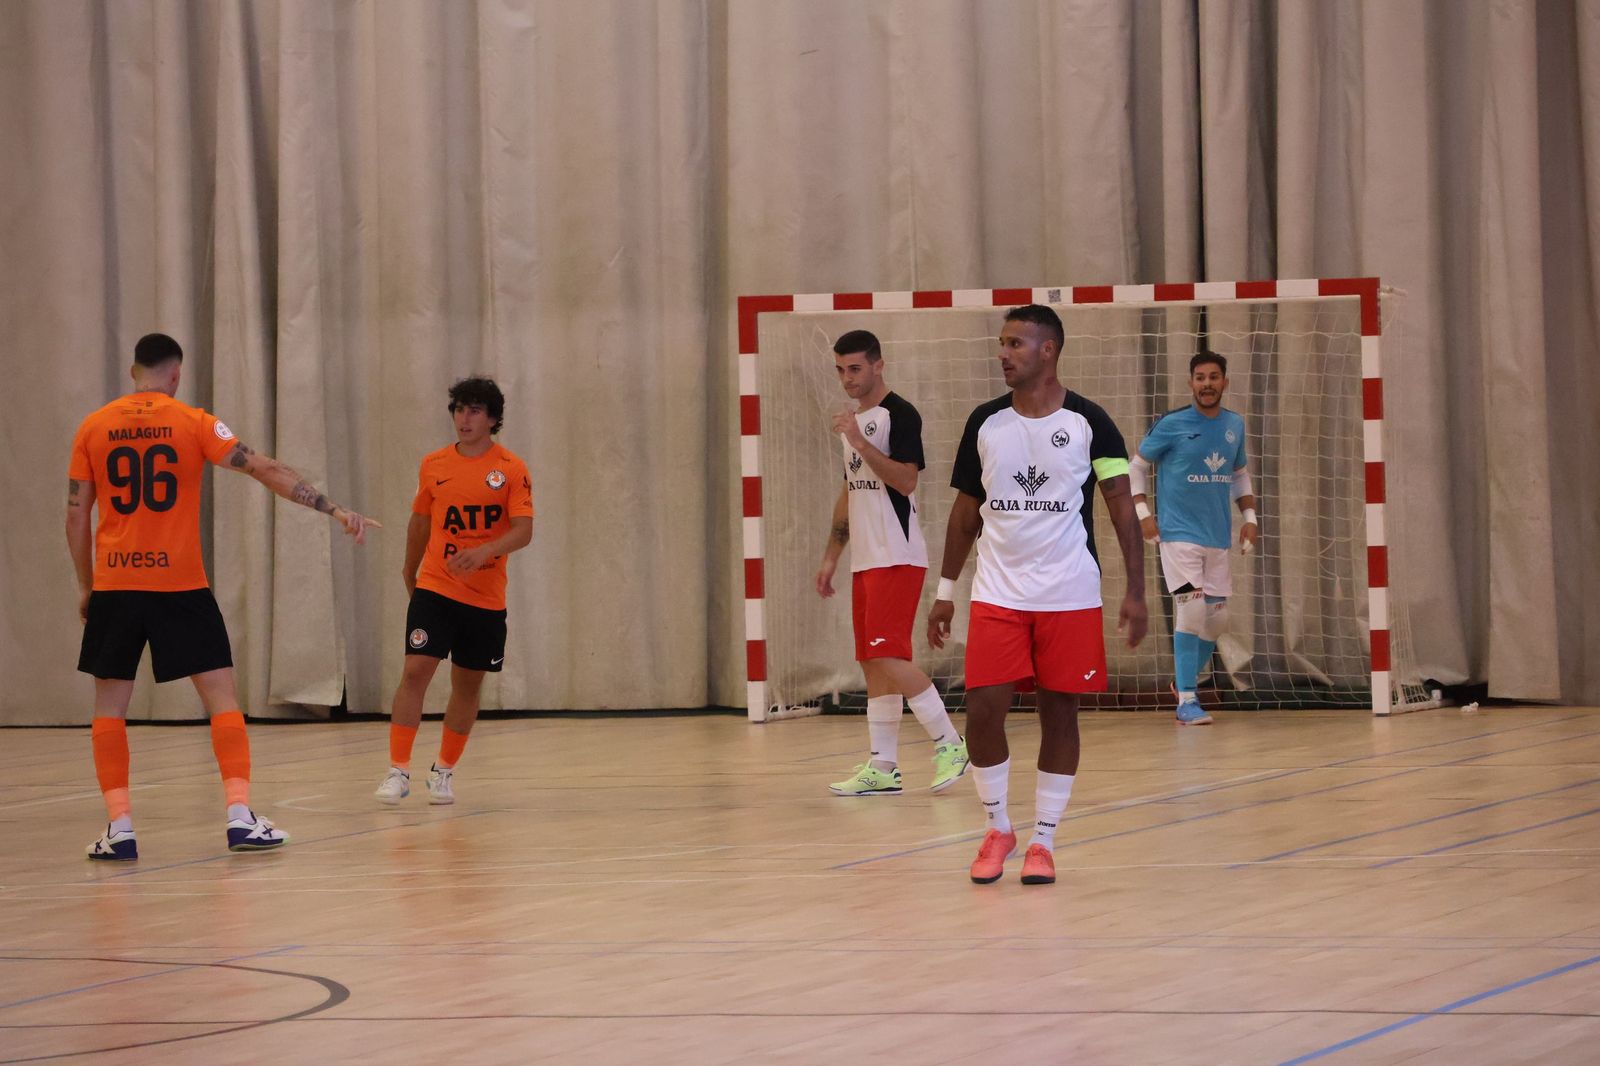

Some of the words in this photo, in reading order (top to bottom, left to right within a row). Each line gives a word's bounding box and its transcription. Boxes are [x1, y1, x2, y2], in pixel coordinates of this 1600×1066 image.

[108, 427, 172, 441] MALAGUTI
[106, 444, 178, 515] 96
[990, 499, 1020, 511] CAJA
[1024, 500, 1069, 512] RURAL
[443, 504, 502, 530] ATP
[107, 551, 169, 568] uvesa
